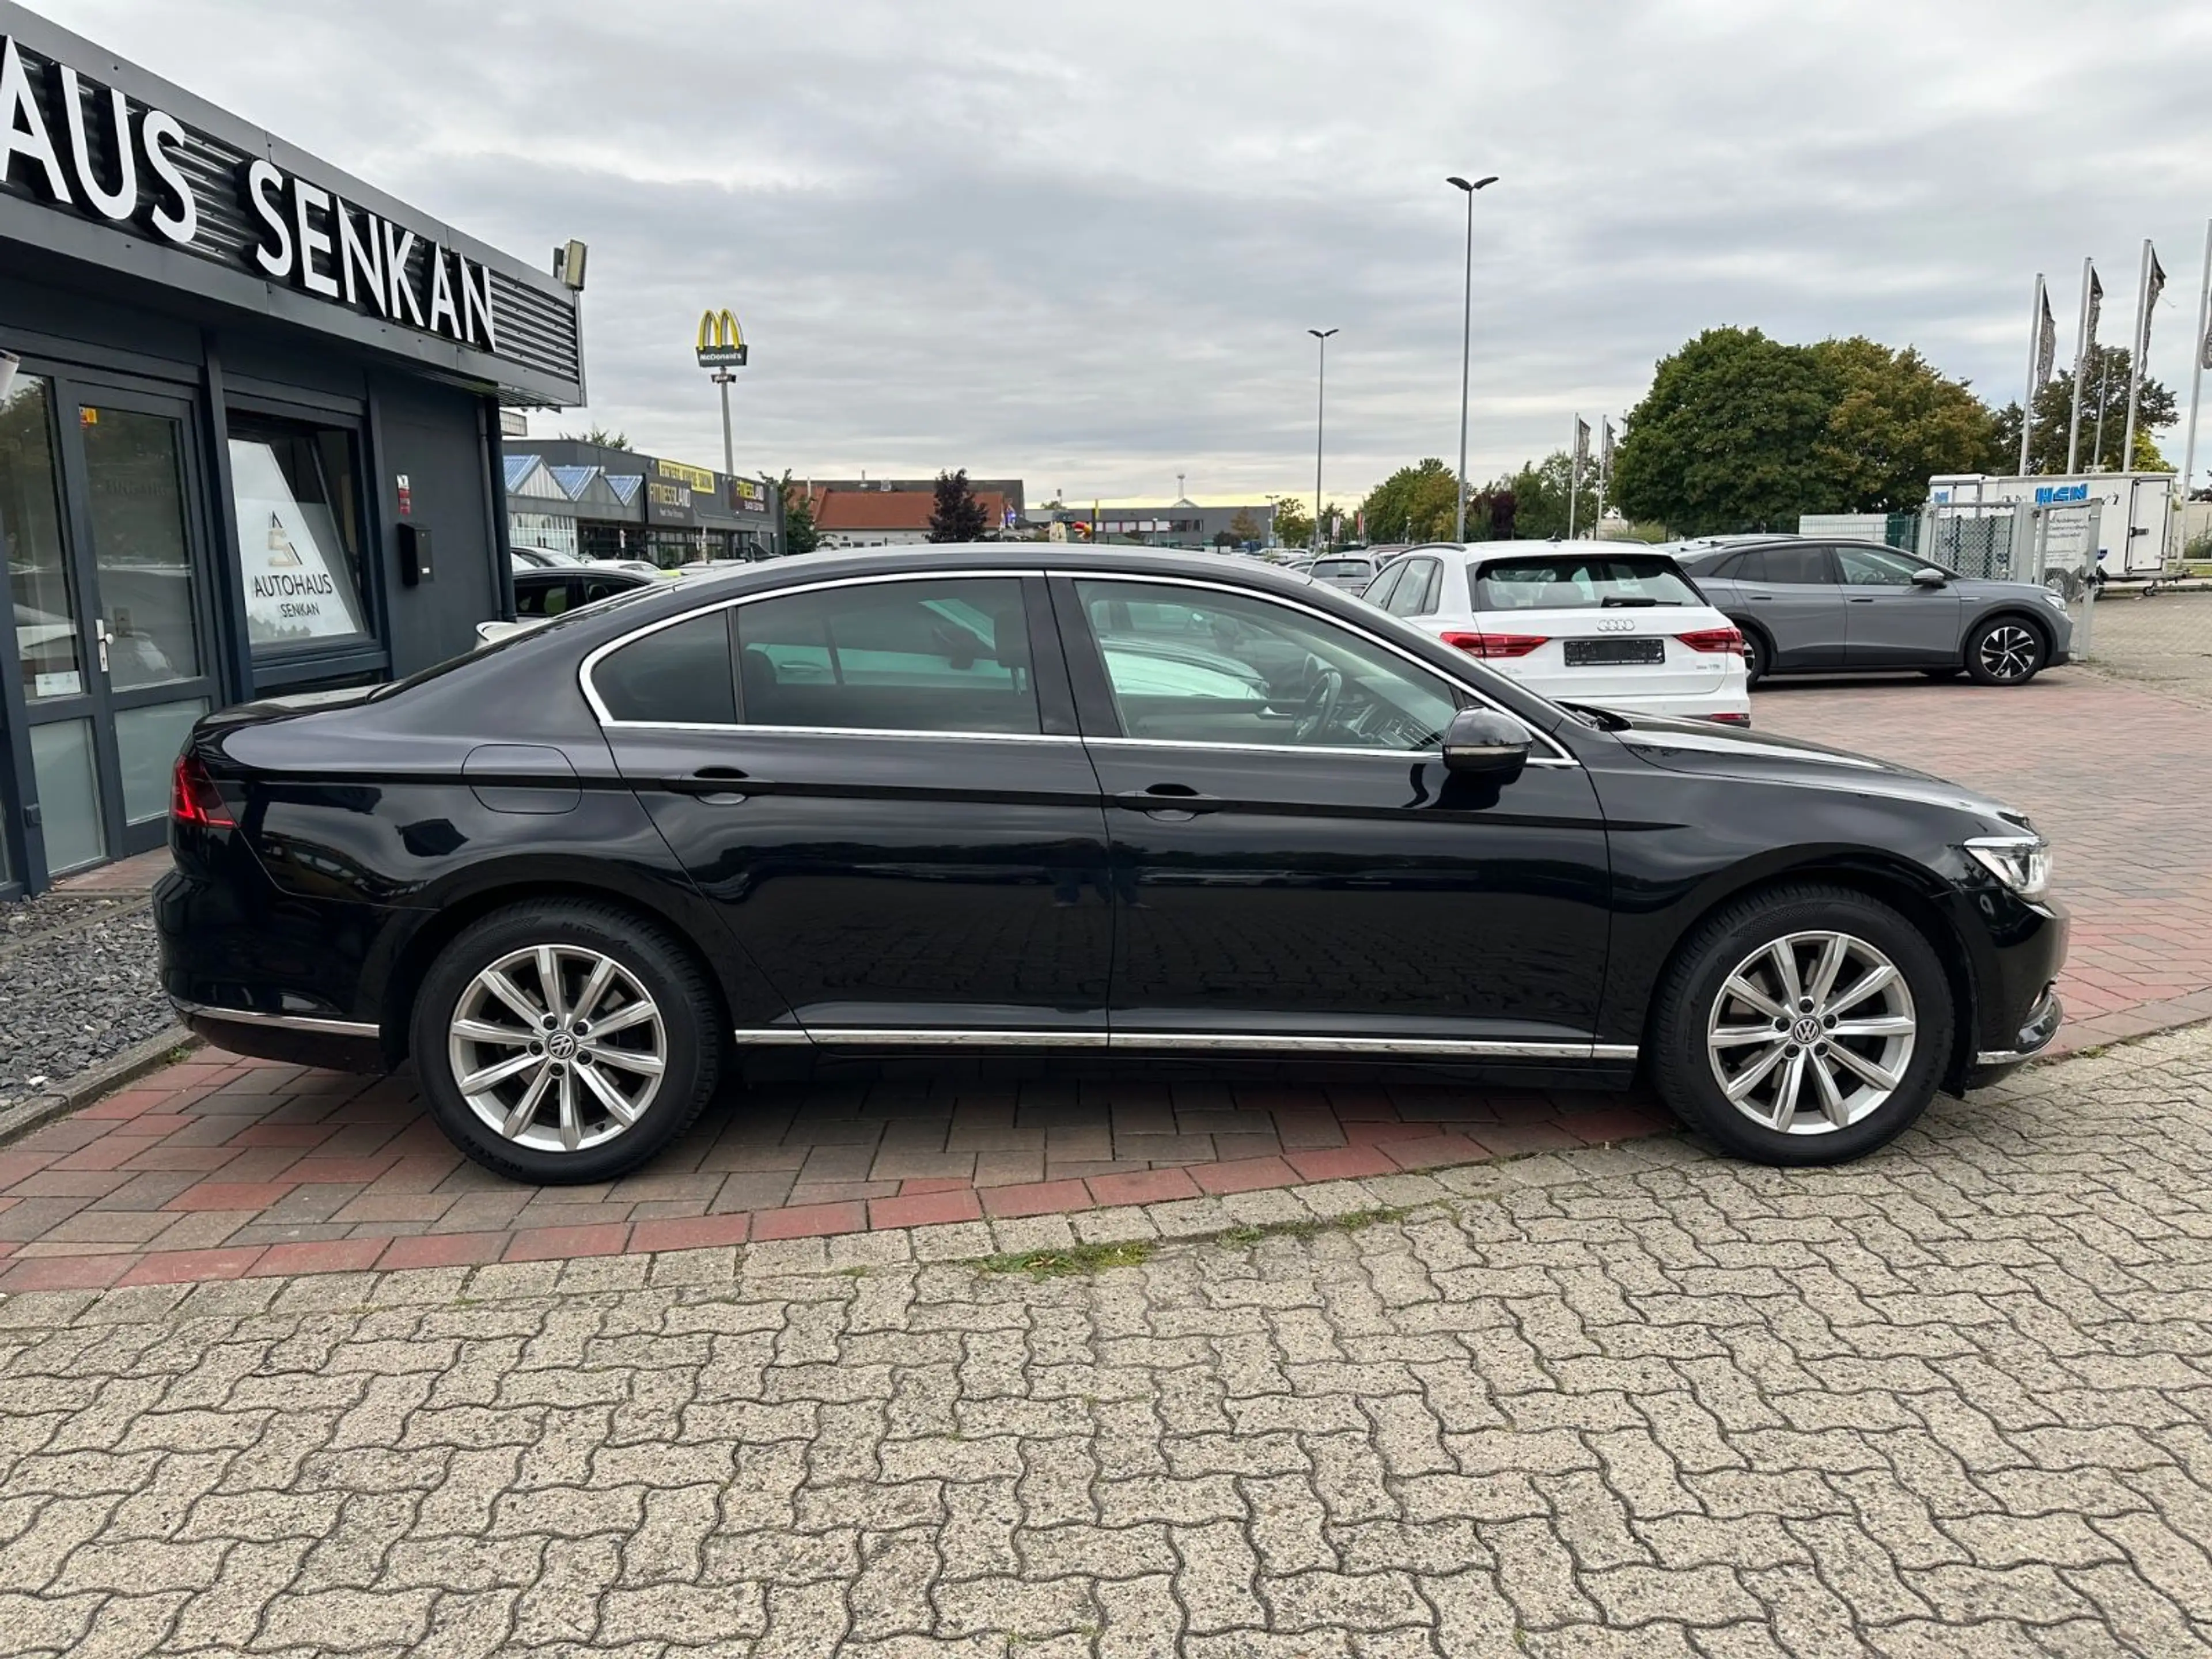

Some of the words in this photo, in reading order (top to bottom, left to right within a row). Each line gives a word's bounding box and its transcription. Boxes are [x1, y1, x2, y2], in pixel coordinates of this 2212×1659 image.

[248, 159, 496, 353] SENKAN
[699, 353, 742, 361] McDonald's
[254, 573, 334, 598] AUTOHAUS
[280, 602, 321, 618] SENKAN
